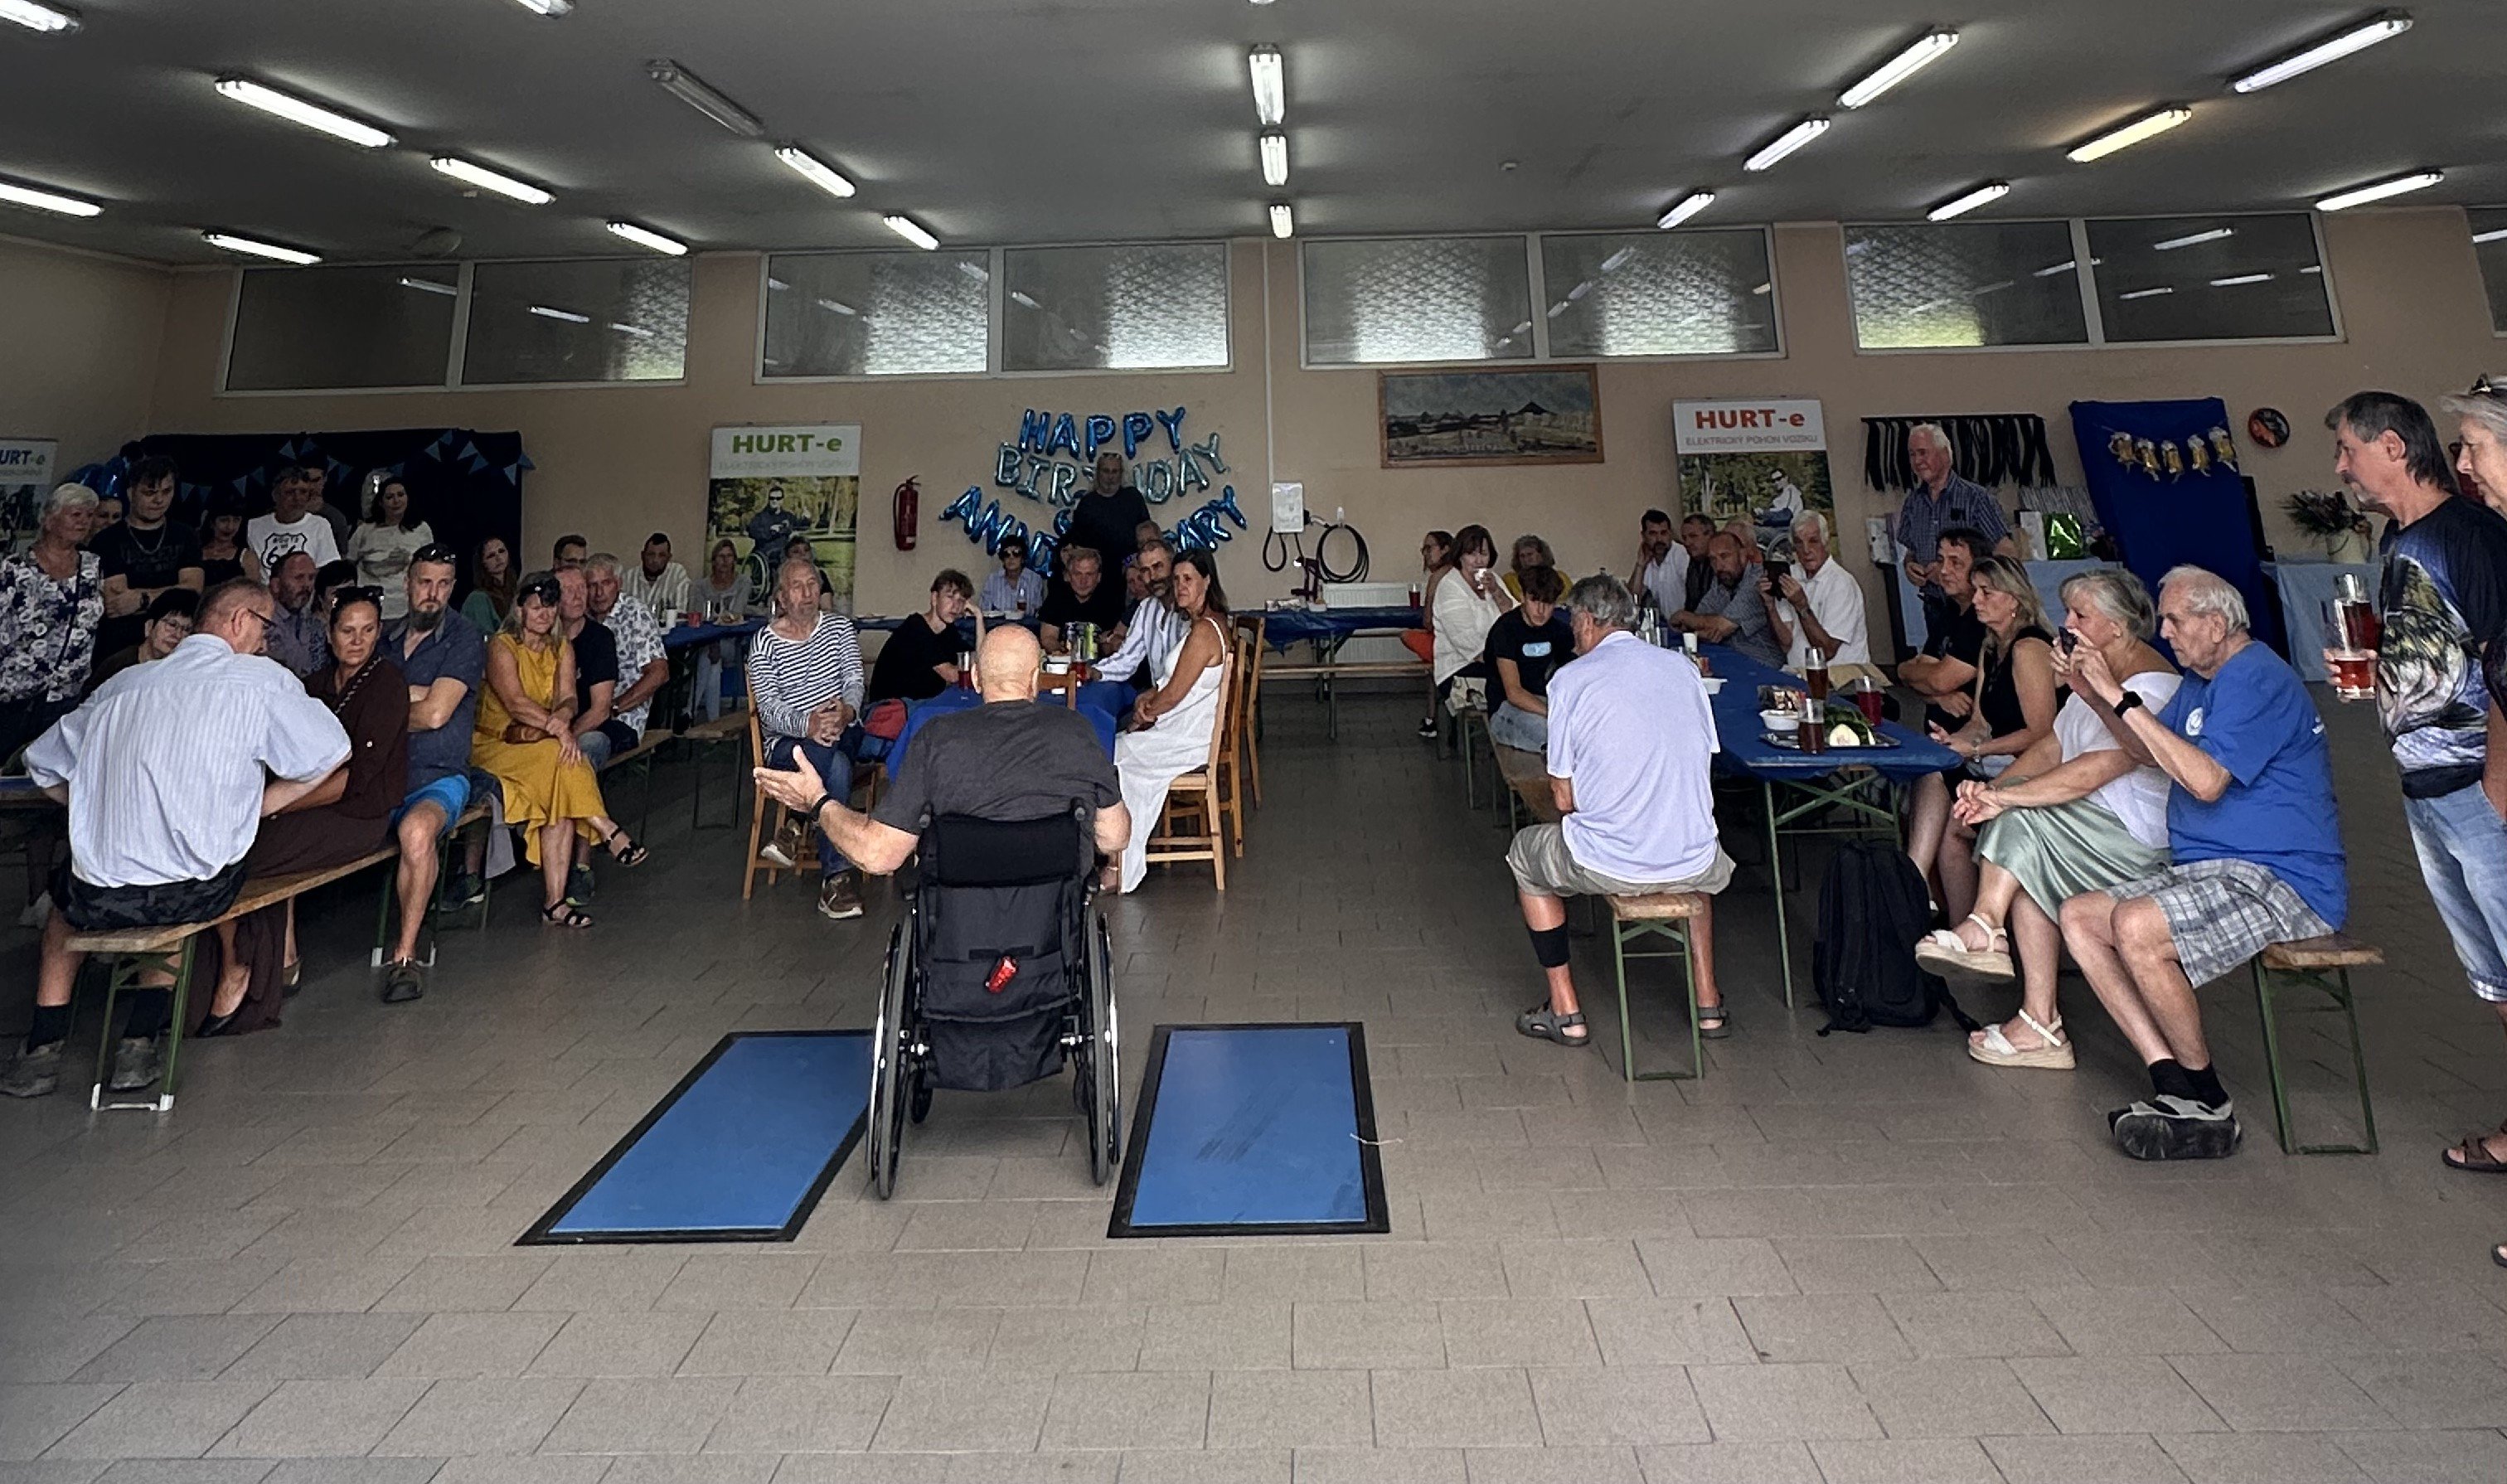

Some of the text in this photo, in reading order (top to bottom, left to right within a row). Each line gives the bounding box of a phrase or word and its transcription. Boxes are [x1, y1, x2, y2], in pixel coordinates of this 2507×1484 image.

[1695, 408, 1806, 429] HURT-e
[732, 434, 842, 453] HURT-e
[1018, 406, 1186, 463] HAPPY
[0, 449, 46, 465] URT-e
[995, 432, 1230, 507] BIRDAY
